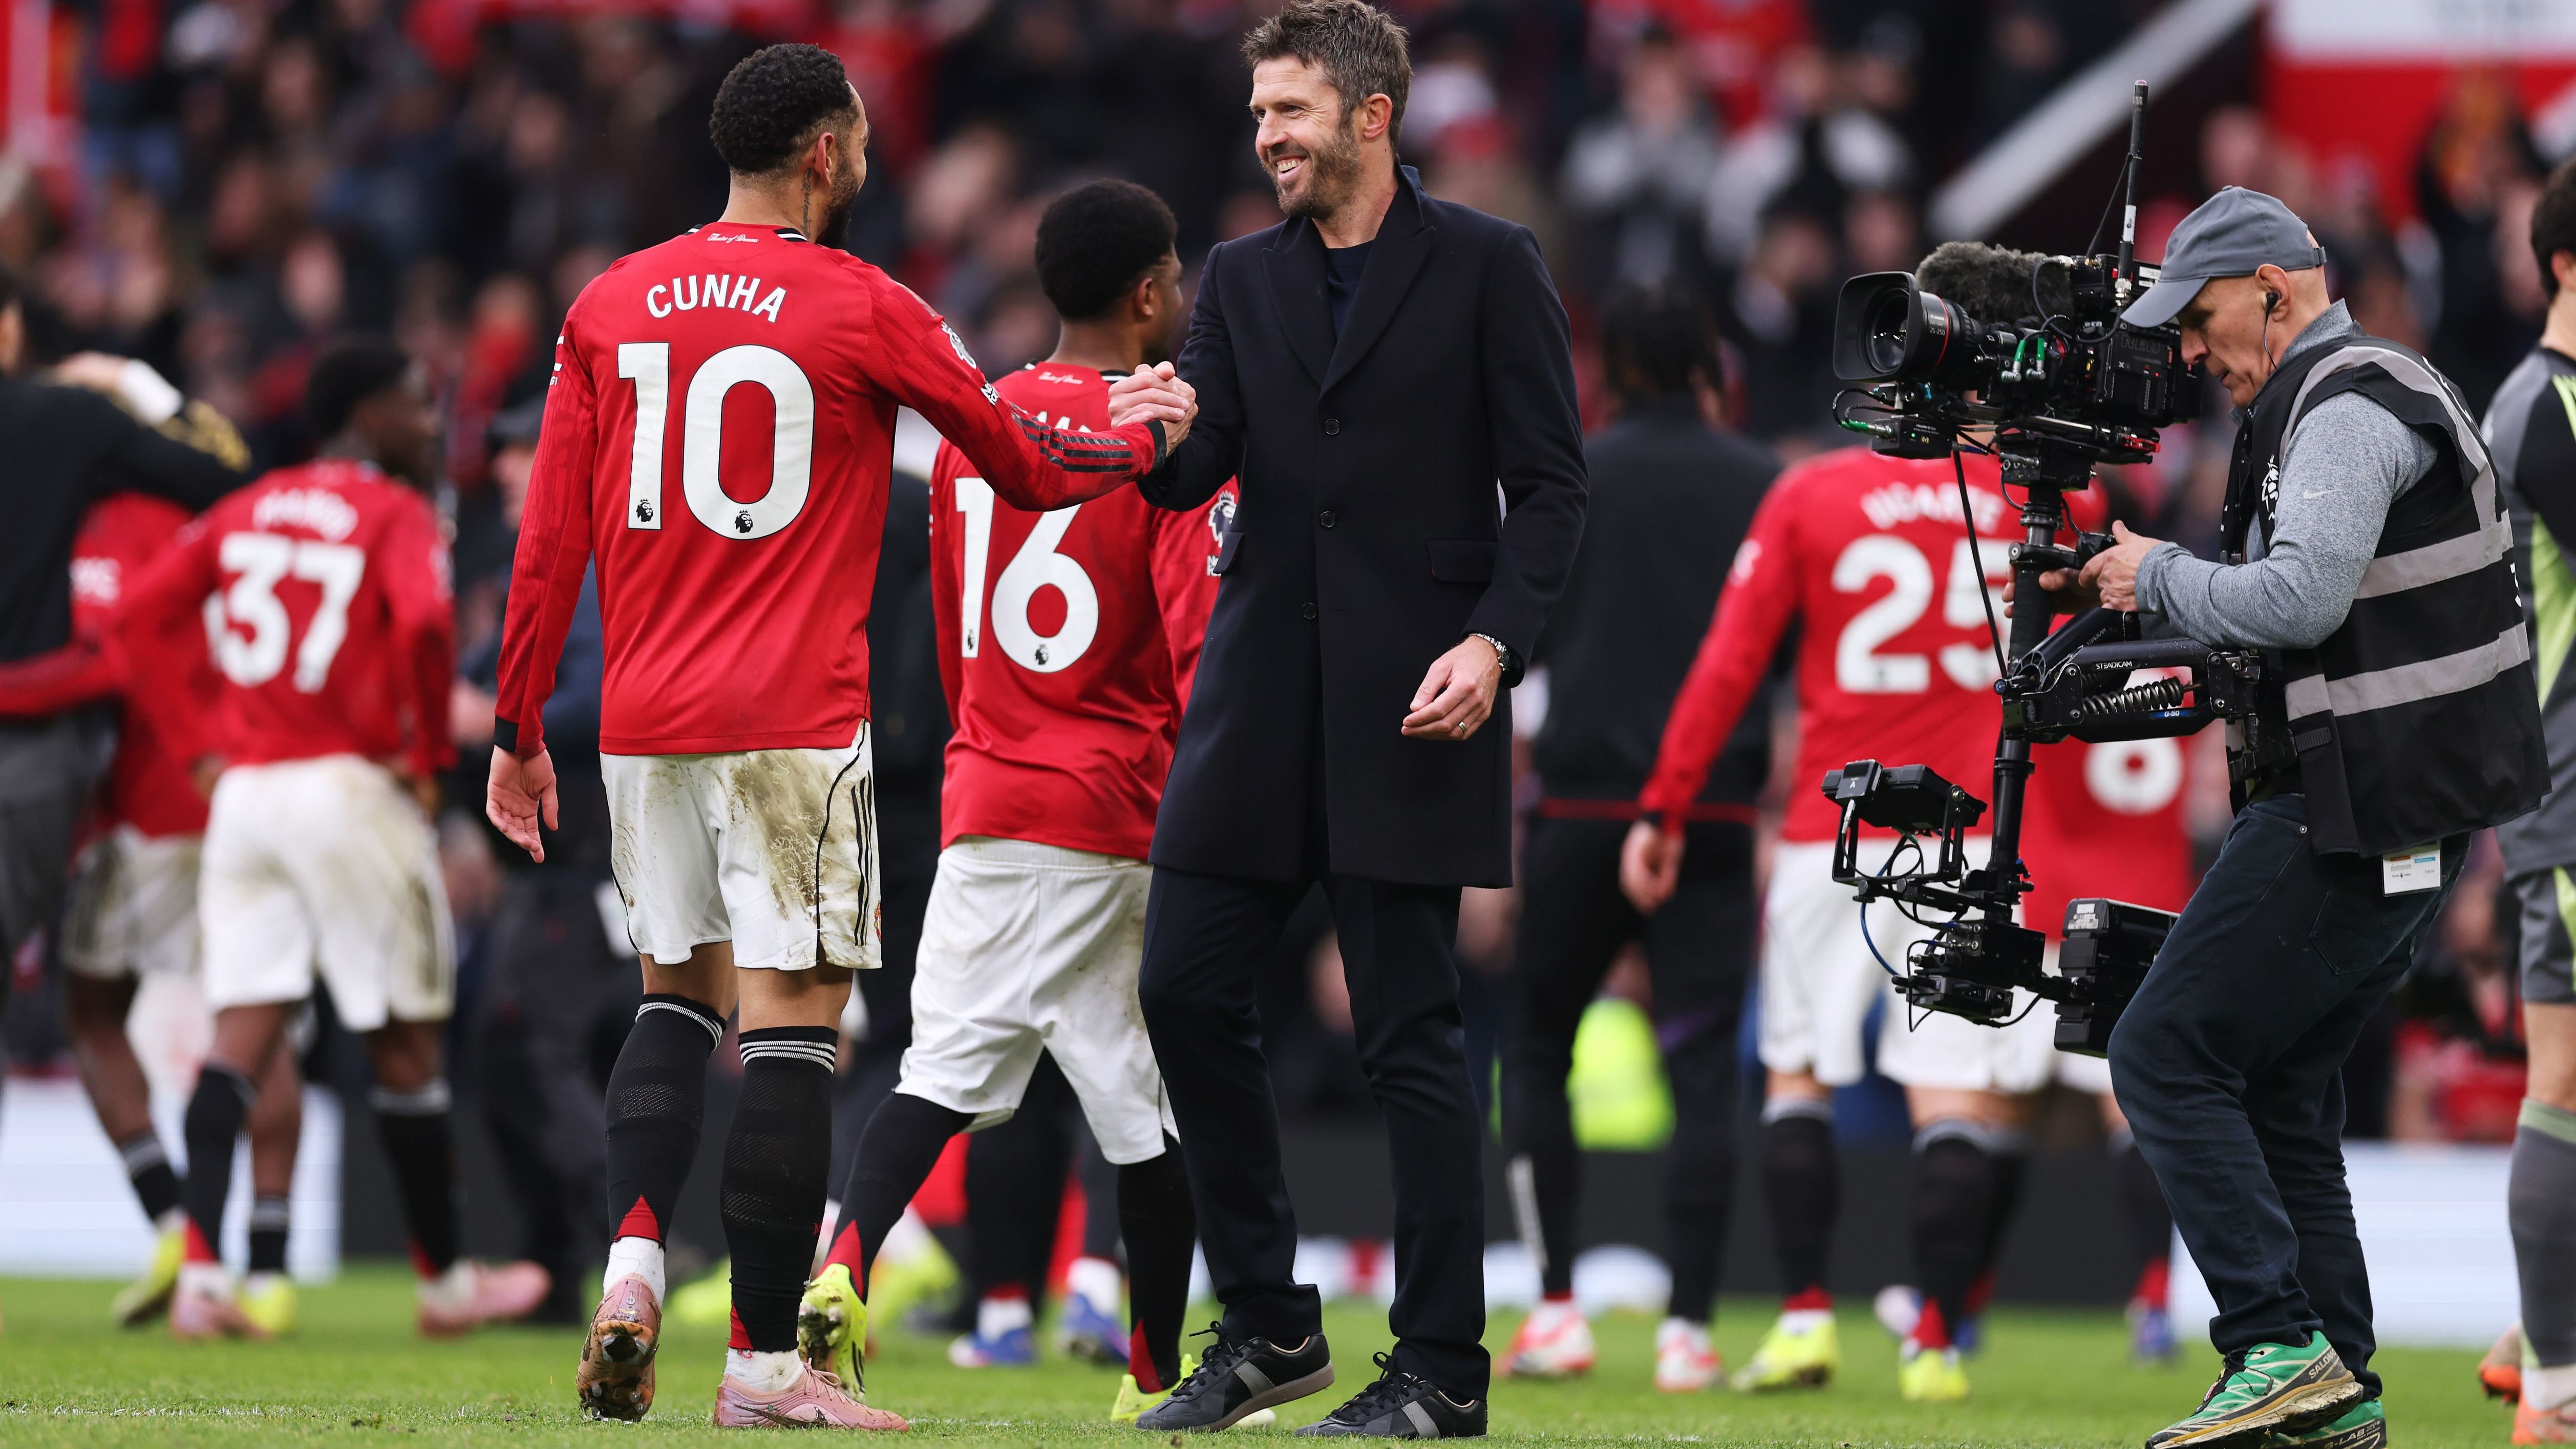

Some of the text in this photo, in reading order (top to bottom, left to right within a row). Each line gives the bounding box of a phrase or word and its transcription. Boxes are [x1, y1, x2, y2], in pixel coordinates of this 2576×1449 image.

[646, 274, 787, 323] CUNHA
[617, 342, 815, 541] 10
[219, 530, 366, 693] 37
[954, 476, 1100, 674] 16
[1830, 531, 2013, 694] 25
[2096, 660, 2133, 670] STEADICAM
